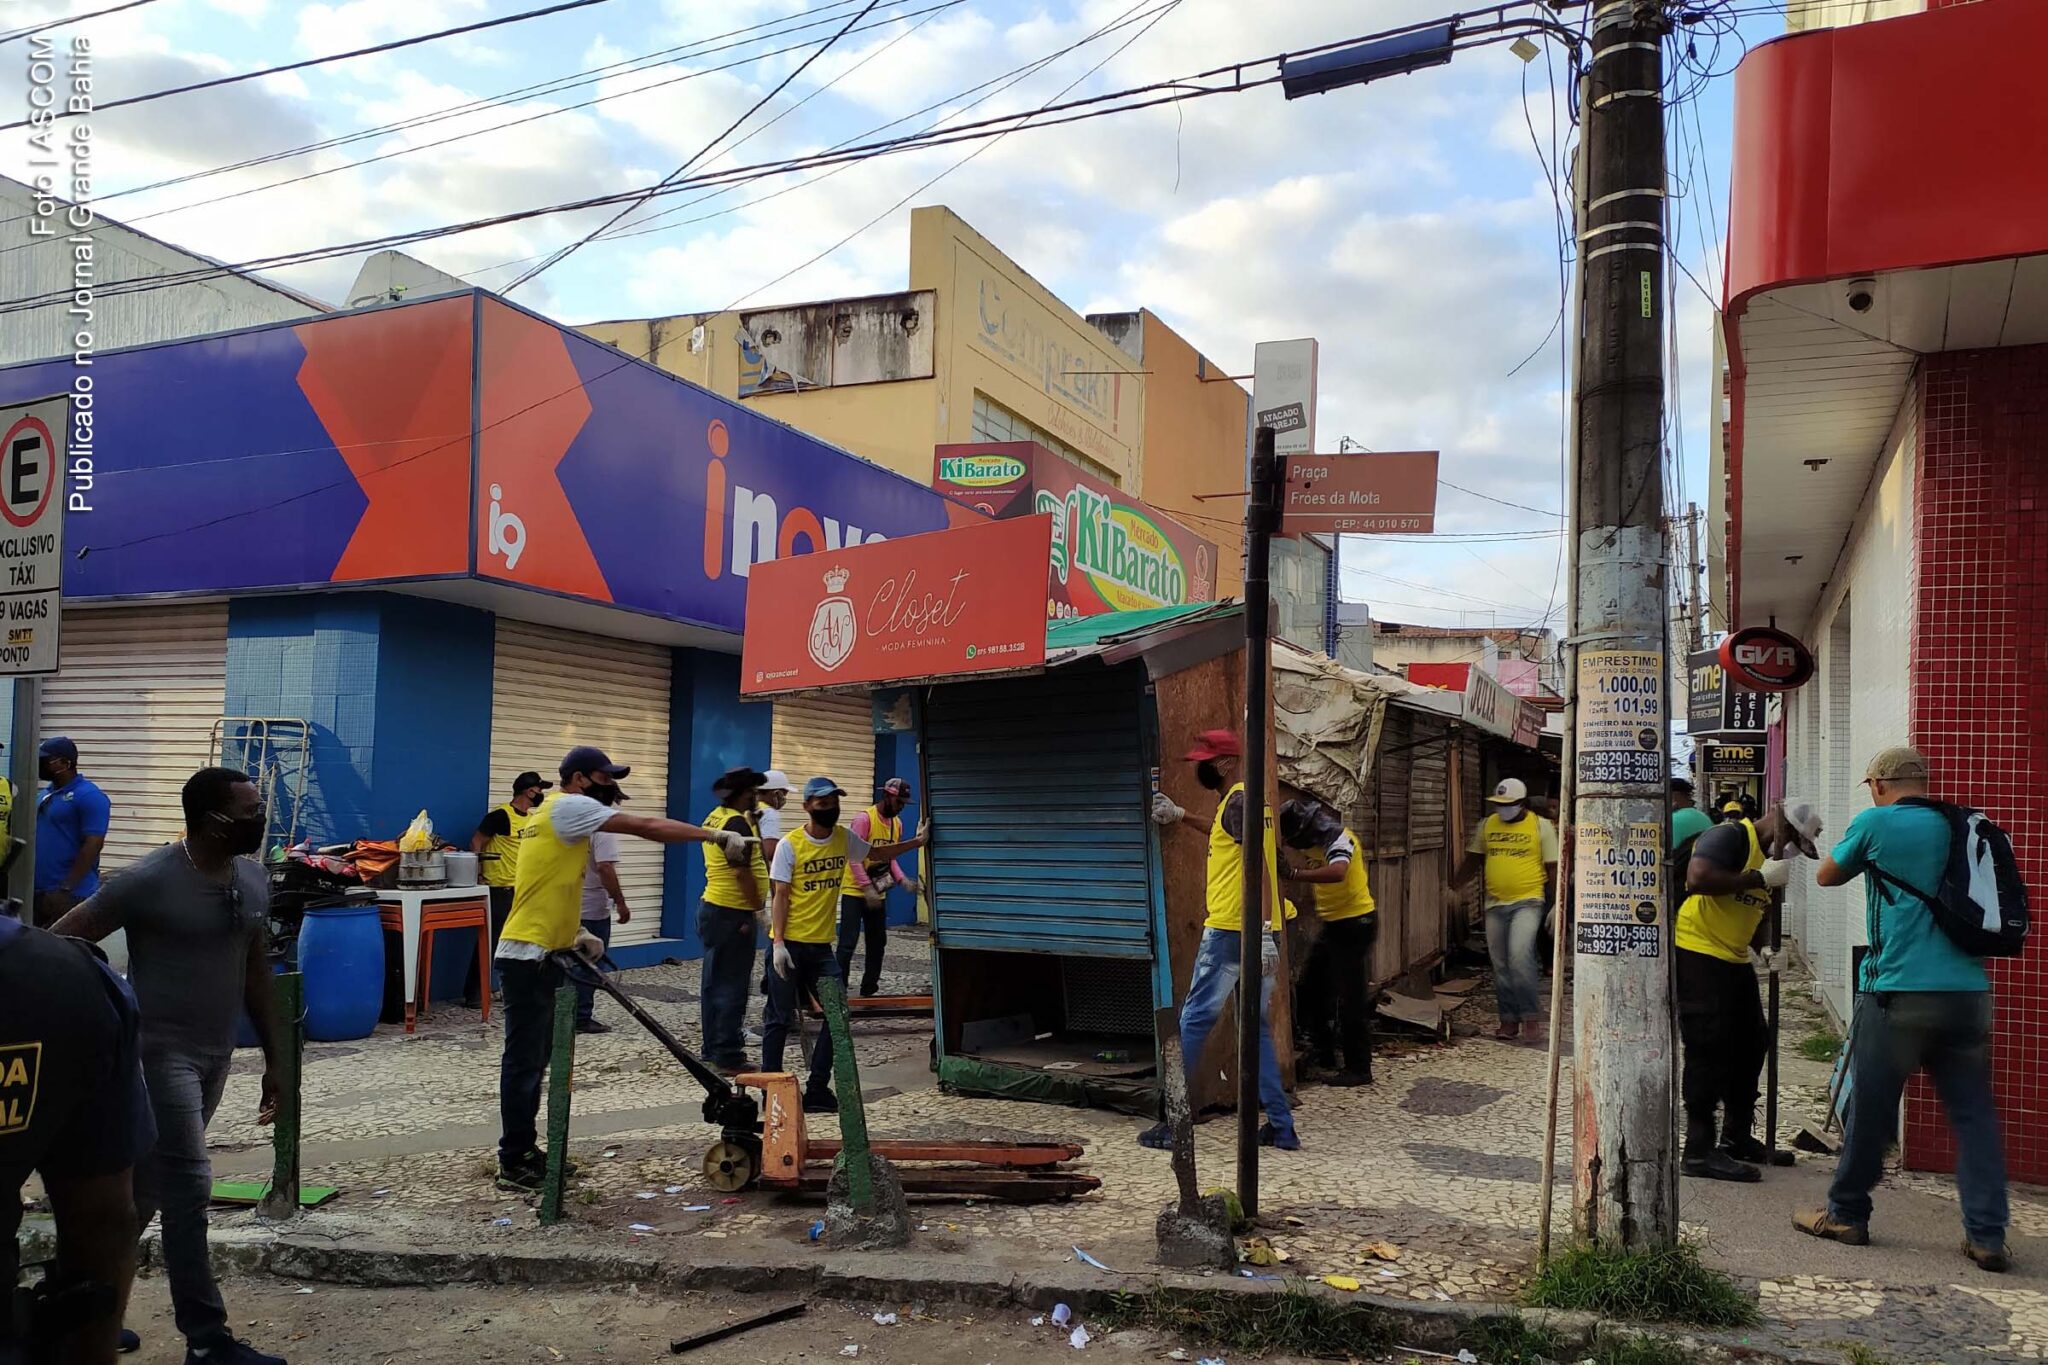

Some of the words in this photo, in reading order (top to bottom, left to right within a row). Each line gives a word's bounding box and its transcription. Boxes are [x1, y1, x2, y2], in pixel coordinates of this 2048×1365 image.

[1262, 407, 1300, 424] ATACADO
[11, 436, 41, 505] E
[1292, 465, 1328, 481] Praça
[1290, 490, 1326, 505] Fróes
[1329, 491, 1345, 505] da
[1349, 491, 1381, 505] Mota
[1334, 519, 1360, 529] CEP:
[1363, 519, 1375, 529] 44
[1378, 519, 1398, 529] 010
[1400, 519, 1420, 529] 570
[1130, 519, 1160, 549] Mercado
[9, 561, 36, 587] TÁXI
[9, 599, 48, 621] VAGAS
[866, 568, 970, 637] Closet
[8, 628, 34, 643] SMTT
[882, 641, 905, 652] MODA
[907, 637, 946, 650] FEMININA
[1598, 675, 1658, 697] 1.000,00
[1692, 663, 1721, 694] ame
[1613, 697, 1658, 716] 101,99
[1583, 720, 1619, 728] DINHEIRO
[1585, 730, 1633, 739] EMPRESTAMOS
[1614, 740, 1636, 748] VALOR
[1712, 746, 1755, 760] ame
[805, 856, 845, 873] APOIO
[1580, 892, 1617, 900] DINHEIRO
[1582, 902, 1631, 911] EMPRESTAMOS
[1611, 912, 1633, 921] VALOR
